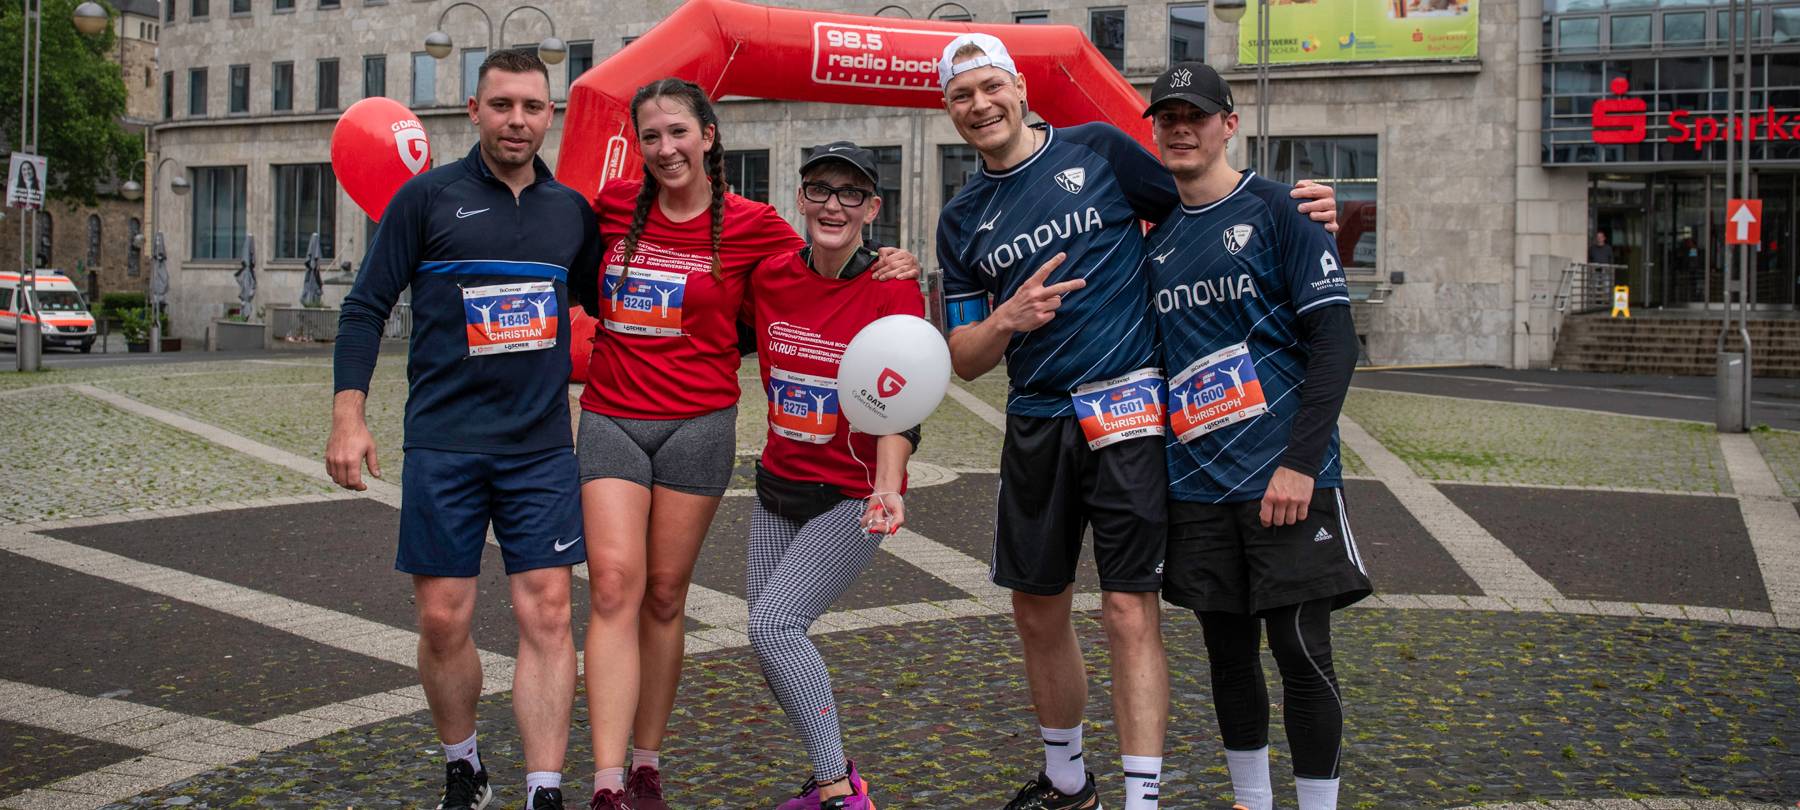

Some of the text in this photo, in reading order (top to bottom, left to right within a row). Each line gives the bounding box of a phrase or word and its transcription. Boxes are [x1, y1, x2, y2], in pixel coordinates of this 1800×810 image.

[827, 30, 883, 50] 98.5
[828, 53, 887, 70] radio
[1311, 279, 1331, 288] THINK
[624, 297, 651, 310] 3249
[500, 314, 529, 327] 1848
[490, 329, 542, 341] CHRISTIAN
[867, 394, 886, 411] DATA
[1195, 385, 1225, 406] 1600
[784, 401, 807, 416] 3275
[1112, 400, 1143, 416] 1601
[1189, 398, 1242, 424] CHRISTOPH
[1103, 415, 1159, 431] CHRISTIAN
